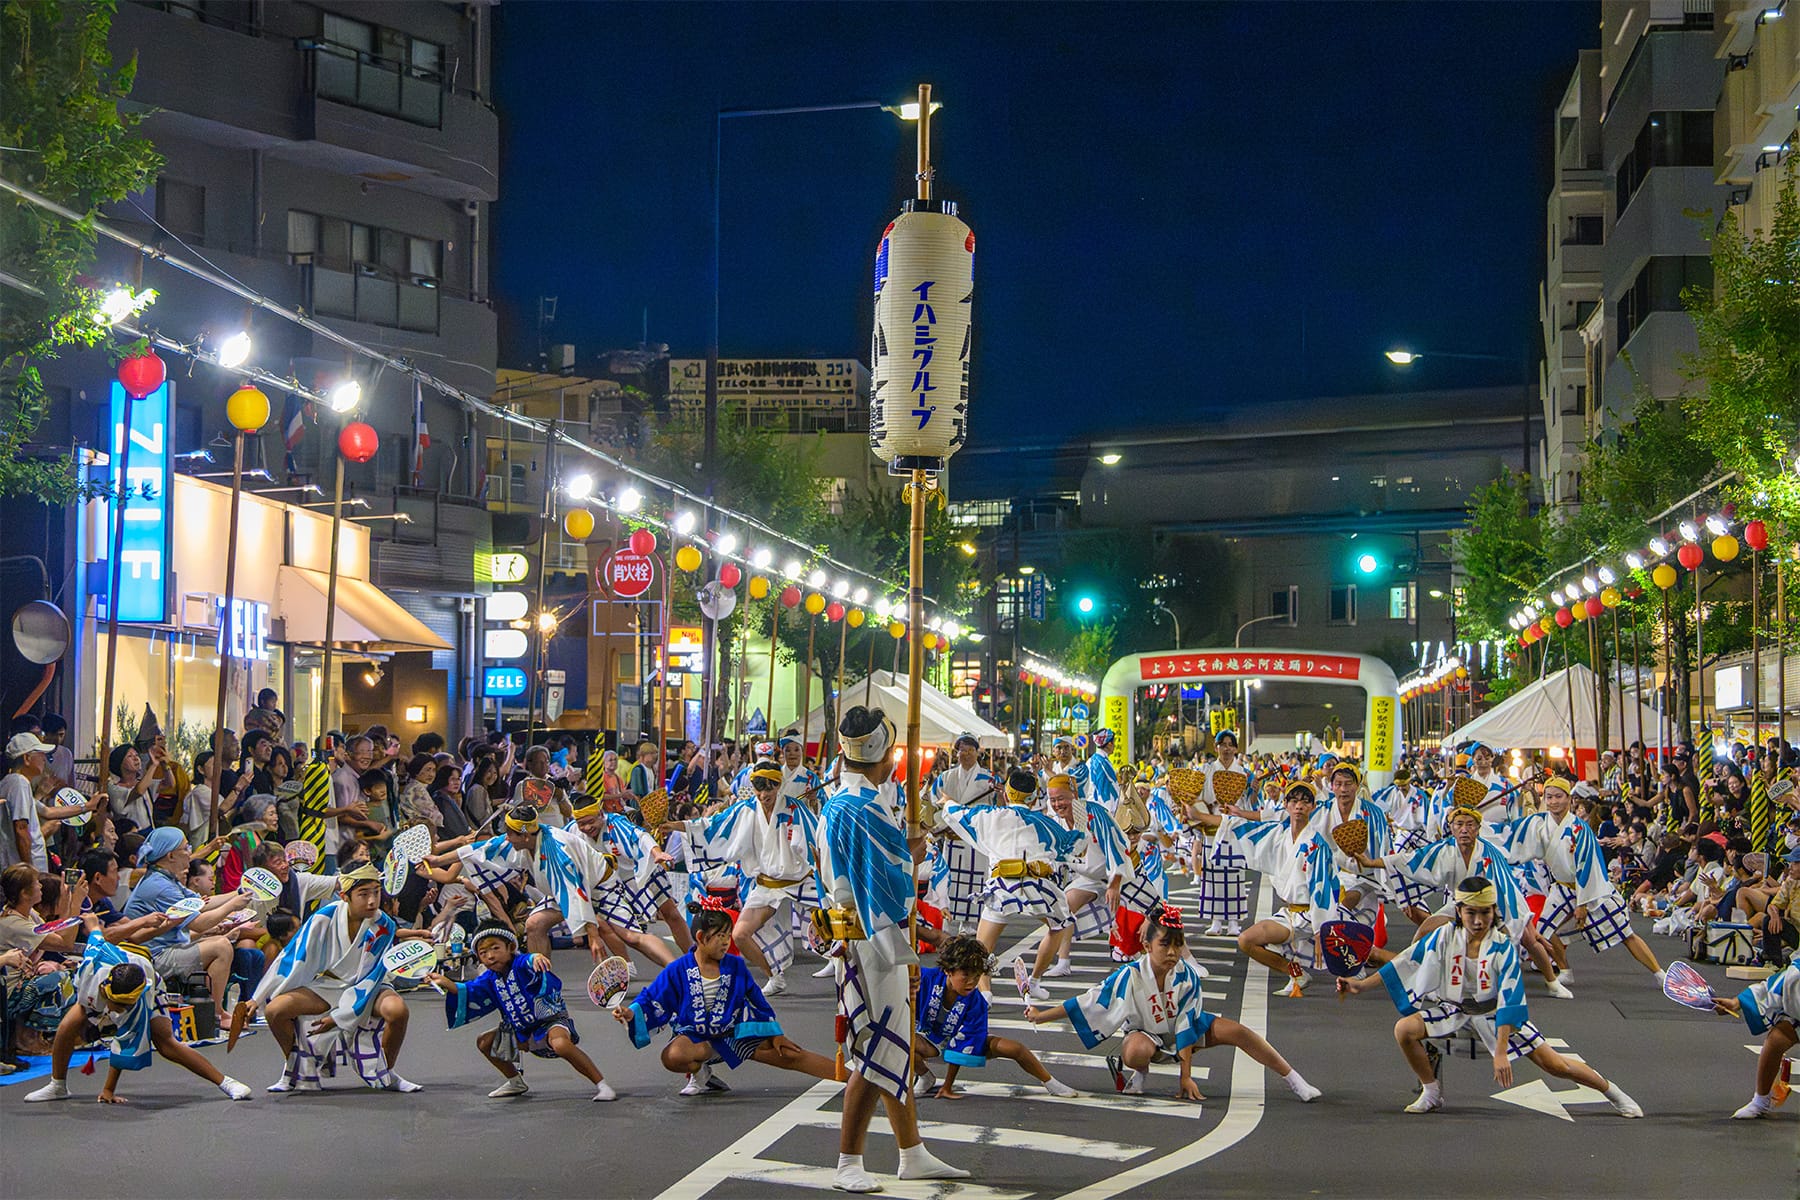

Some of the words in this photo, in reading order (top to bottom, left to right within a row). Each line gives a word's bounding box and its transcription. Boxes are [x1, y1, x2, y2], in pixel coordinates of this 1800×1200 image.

[613, 562, 650, 582] 消火栓
[487, 675, 523, 689] ZELE
[252, 870, 280, 891] POLUS
[387, 942, 423, 964] POLUS
[1451, 954, 1463, 986] イハシ
[1478, 959, 1491, 990] イハシ
[1148, 994, 1164, 1024] イハシ
[1165, 990, 1177, 1019] イハシ
